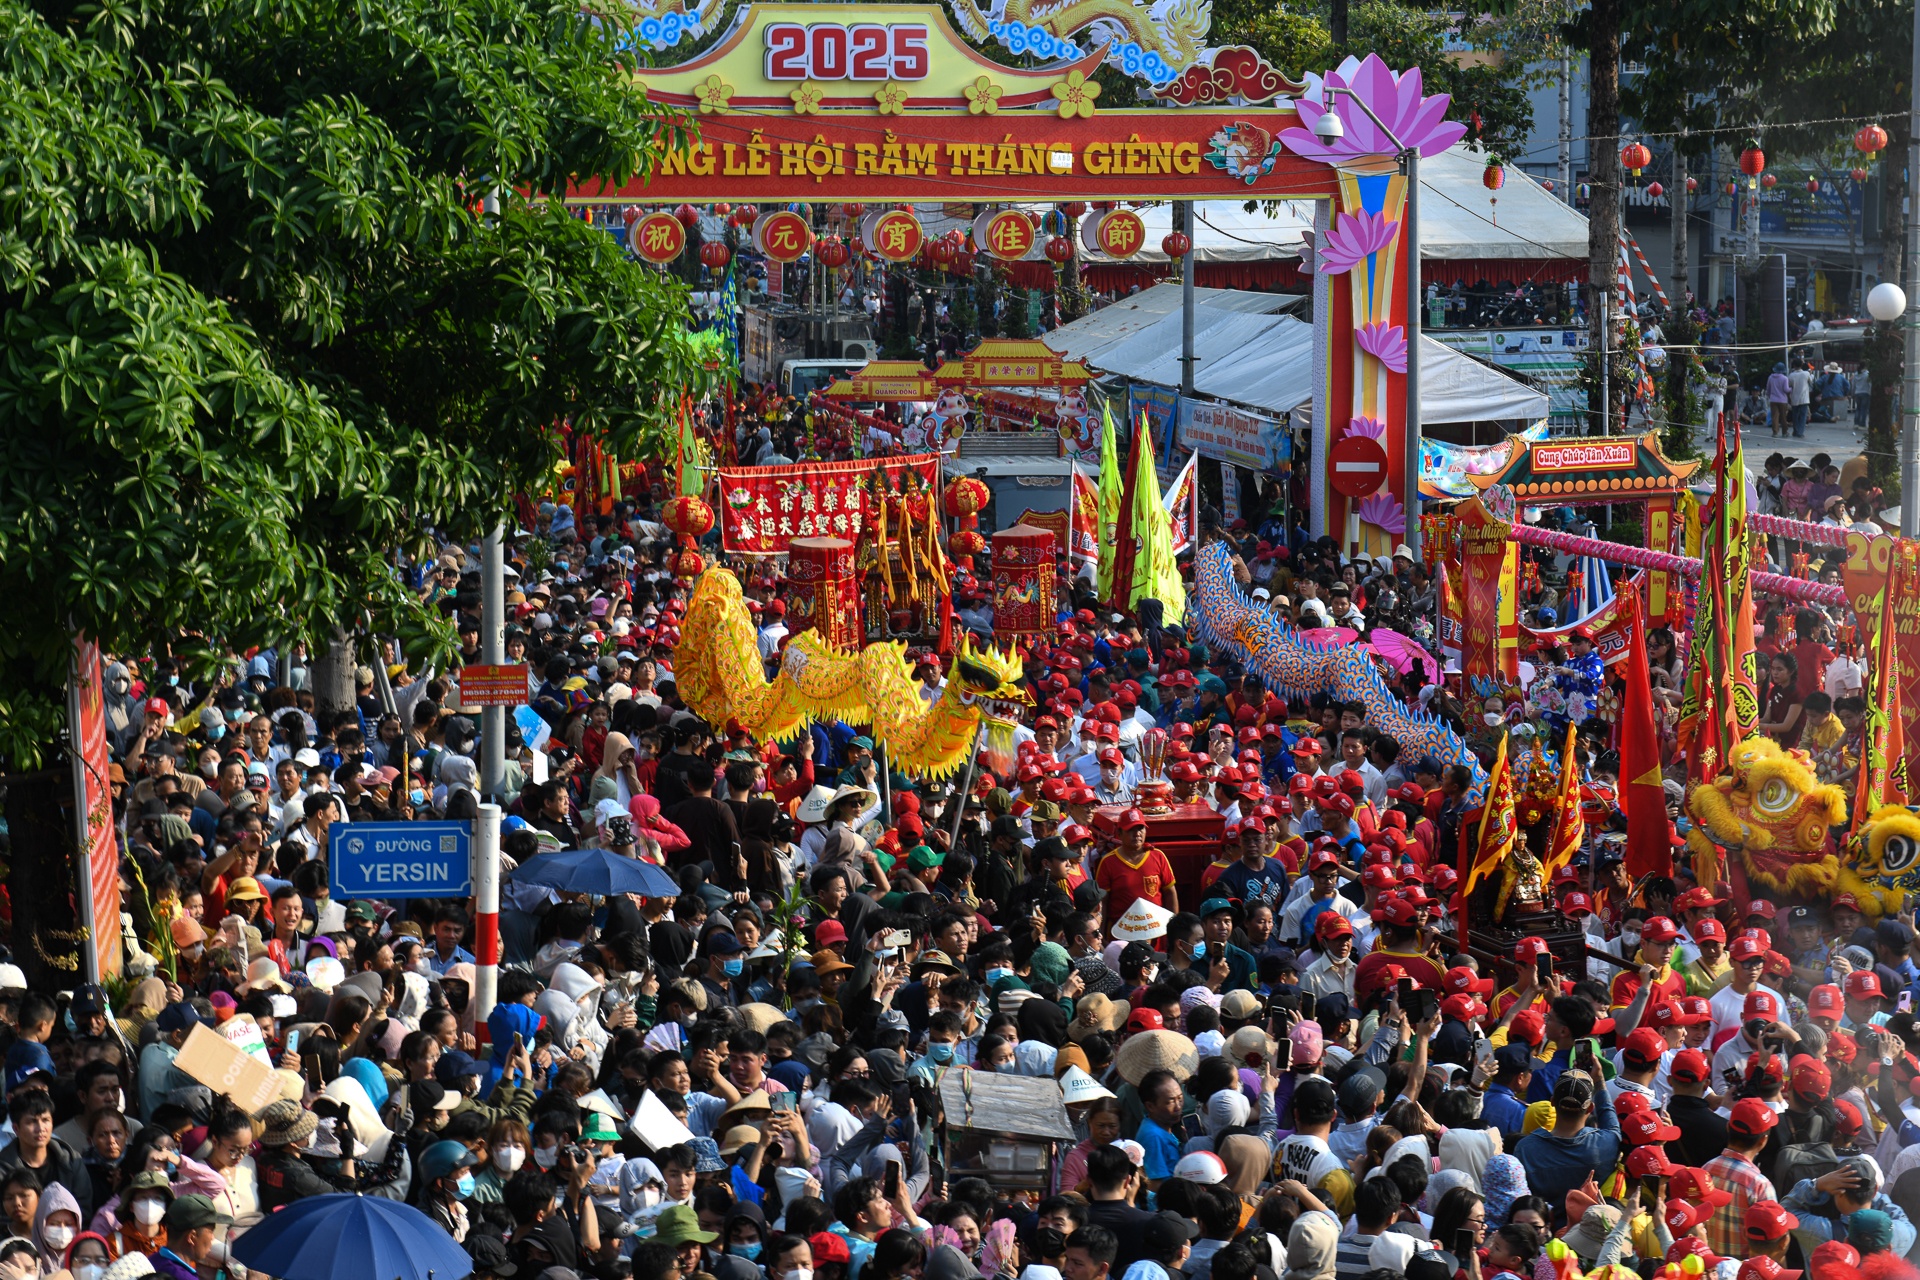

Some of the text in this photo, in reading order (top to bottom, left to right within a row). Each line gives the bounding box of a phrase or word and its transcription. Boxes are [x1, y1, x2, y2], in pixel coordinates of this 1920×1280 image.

[767, 24, 930, 80] 2025
[723, 128, 771, 176] LỄ
[780, 134, 846, 183] HỘI
[855, 128, 938, 176] RẰM
[946, 133, 1074, 176] THÁNG
[1083, 133, 1201, 175] GIÊNG
[645, 220, 1134, 252] 祝 元 宵 佳 節
[875, 387, 897, 395] QUẢNG
[1538, 446, 1629, 467] Cung Chúc Tân Xuân
[1481, 522, 1507, 543] Mừng
[1656, 518, 1663, 528] An
[1466, 541, 1499, 555] Năm Mới
[1471, 563, 1484, 584] Vạn
[1473, 595, 1482, 617] Sự
[1472, 627, 1486, 644] Như
[375, 837, 432, 852] ĐƯỜNG
[360, 863, 448, 882] YERSIN
